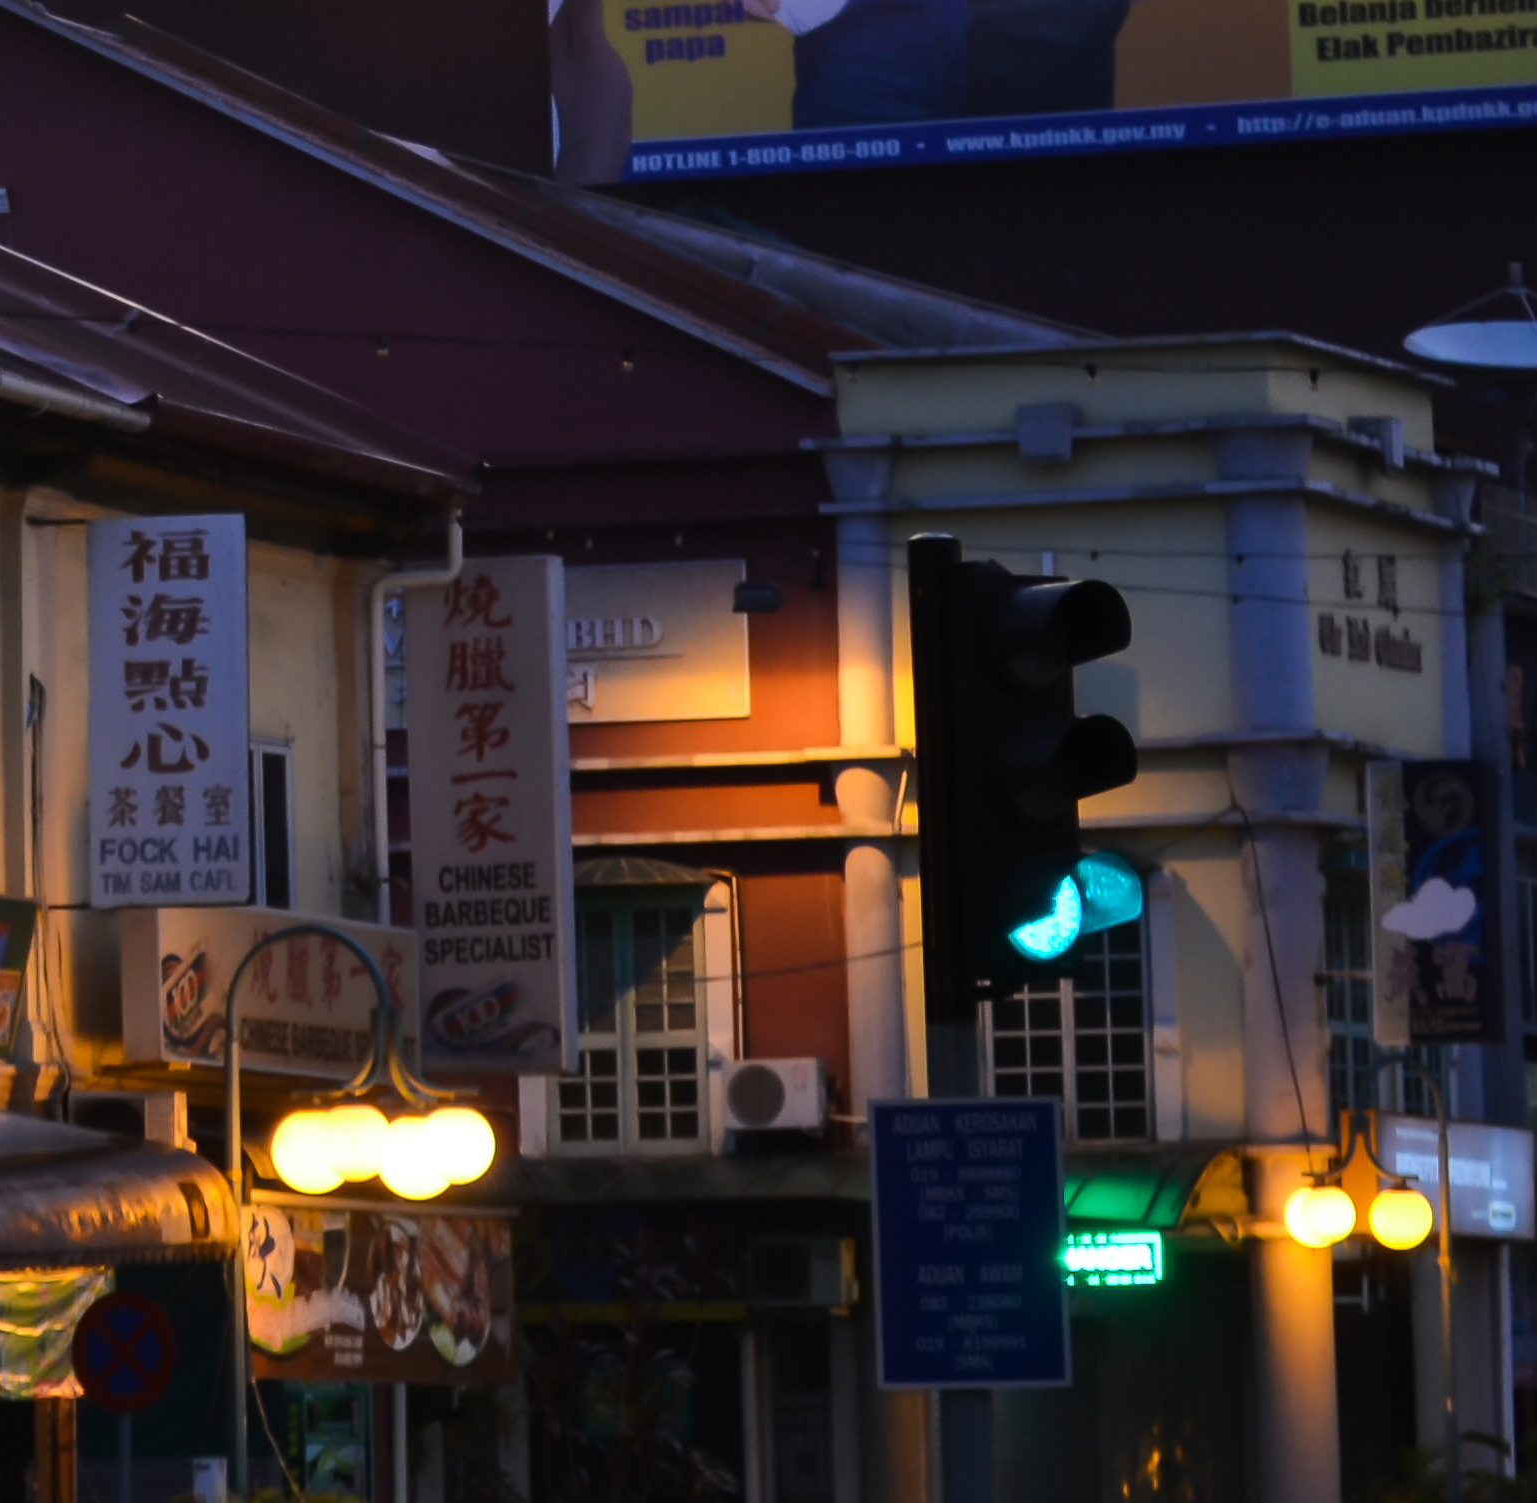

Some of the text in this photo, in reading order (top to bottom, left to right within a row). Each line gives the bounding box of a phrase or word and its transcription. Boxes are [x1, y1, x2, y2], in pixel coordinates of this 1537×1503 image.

[645, 34, 726, 64] papa
[1317, 33, 1380, 63] Elak
[632, 150, 723, 173] HOTLINE
[565, 616, 665, 651] BHD
[119, 528, 211, 776] 福海點心
[108, 783, 235, 827] 茶餐室
[99, 832, 240, 866] FOCK HAI
[101, 871, 132, 895] TIM
[139, 869, 182, 894] SAM
[438, 862, 536, 893] CHINESE
[425, 896, 552, 929] BARBEQUE
[425, 933, 555, 965] SPECIALIST
[892, 1111, 1038, 1135] ADUAN KEROSAKAN
[906, 1137, 1023, 1161] LAMPU ISYARAT
[917, 1262, 1024, 1286] ADUAN AWAM
